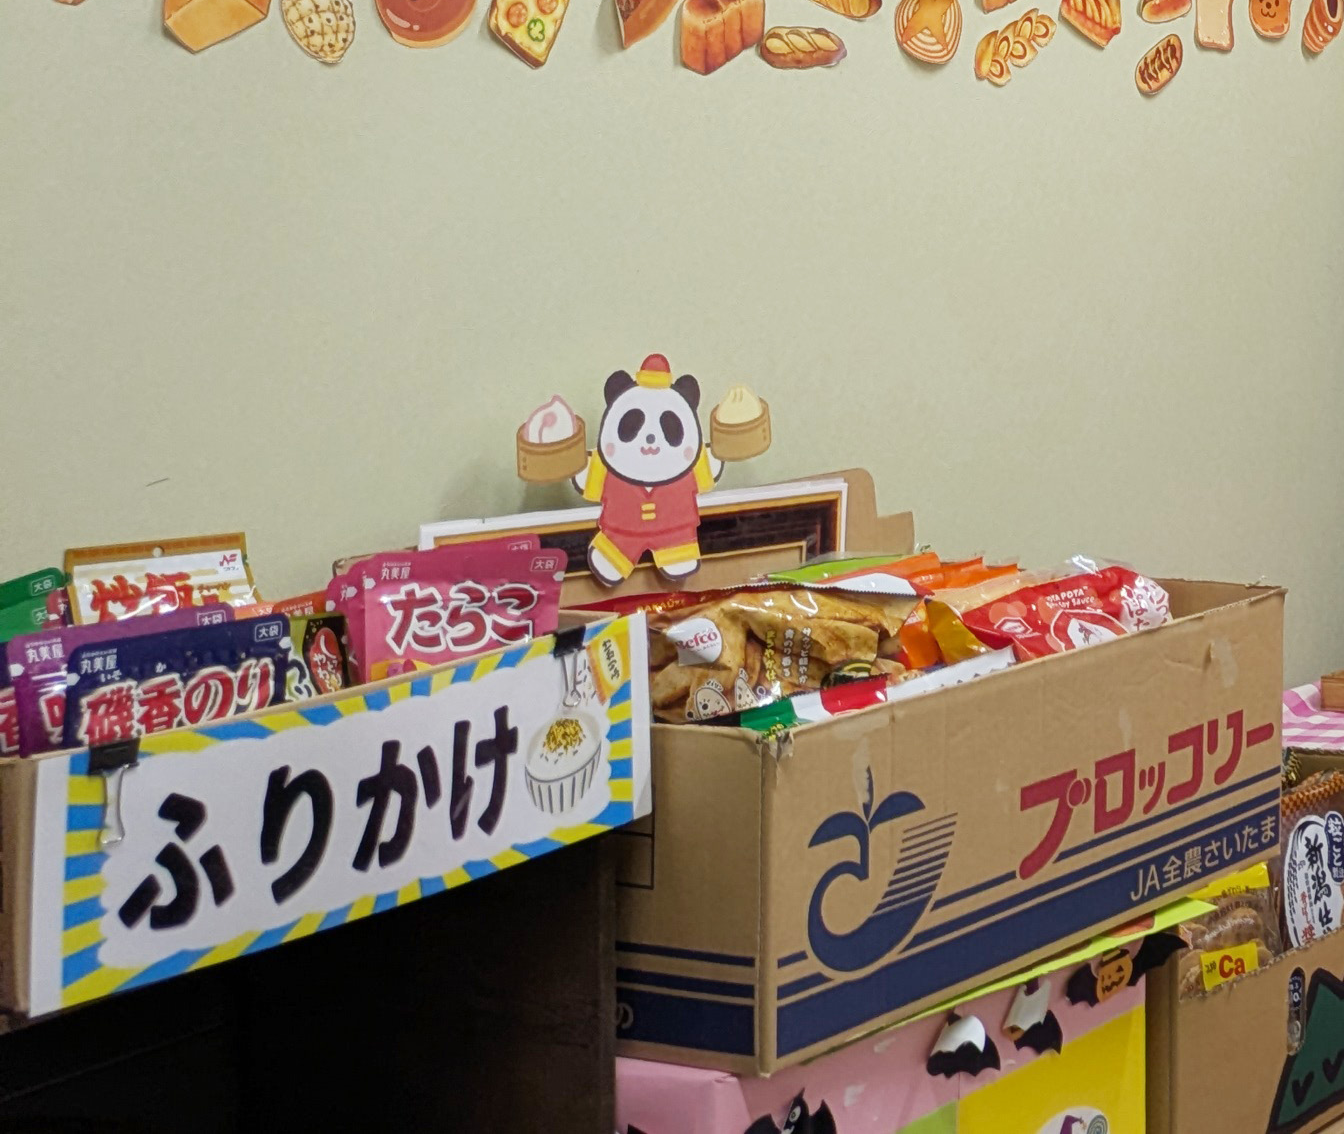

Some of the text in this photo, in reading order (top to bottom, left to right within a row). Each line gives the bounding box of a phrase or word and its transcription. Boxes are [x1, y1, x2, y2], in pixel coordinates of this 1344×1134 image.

[380, 565, 411, 581] 丸美屋
[25, 642, 65, 664] 丸美屋
[257, 627, 280, 640] 大袋
[385, 580, 540, 655] たらこ
[79, 654, 118, 675] 丸美屋
[80, 658, 275, 746] 磯香のり
[118, 704, 520, 931] ふりかけ
[1018, 708, 1275, 881] ブロッコリー
[1129, 815, 1277, 902] JA全農さいたま
[1304, 832, 1333, 935] 新潟仕
[1218, 954, 1246, 980] Ca
